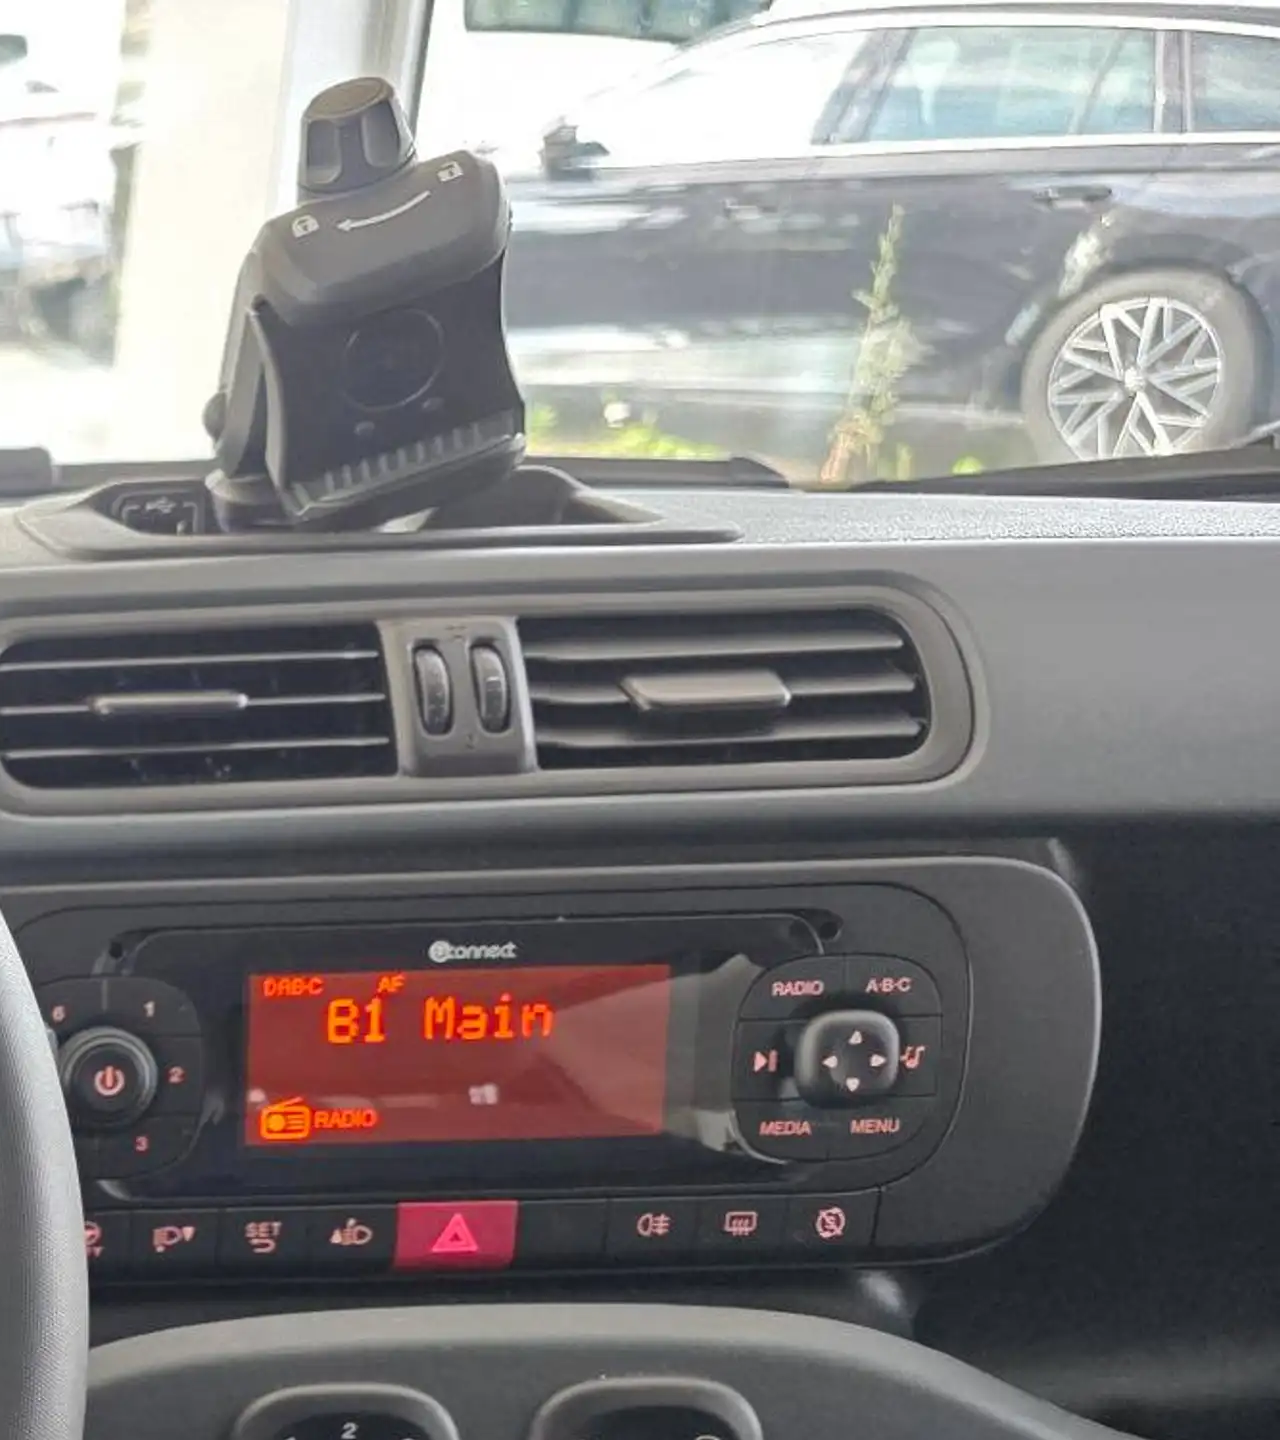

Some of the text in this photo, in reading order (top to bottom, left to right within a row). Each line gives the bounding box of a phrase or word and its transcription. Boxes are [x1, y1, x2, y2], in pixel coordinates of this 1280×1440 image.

[377, 975, 406, 993] AF
[772, 981, 824, 996] RADIO
[144, 1002, 155, 1017] 1
[327, 994, 553, 1043] B1 Main
[169, 1067, 184, 1083] 2
[315, 1111, 378, 1130] RADIO
[759, 1121, 812, 1136] MEDIA
[851, 1119, 900, 1134] MENU
[136, 1137, 148, 1152] 3
[246, 1222, 282, 1238] SET
[342, 1422, 359, 1440] 2
